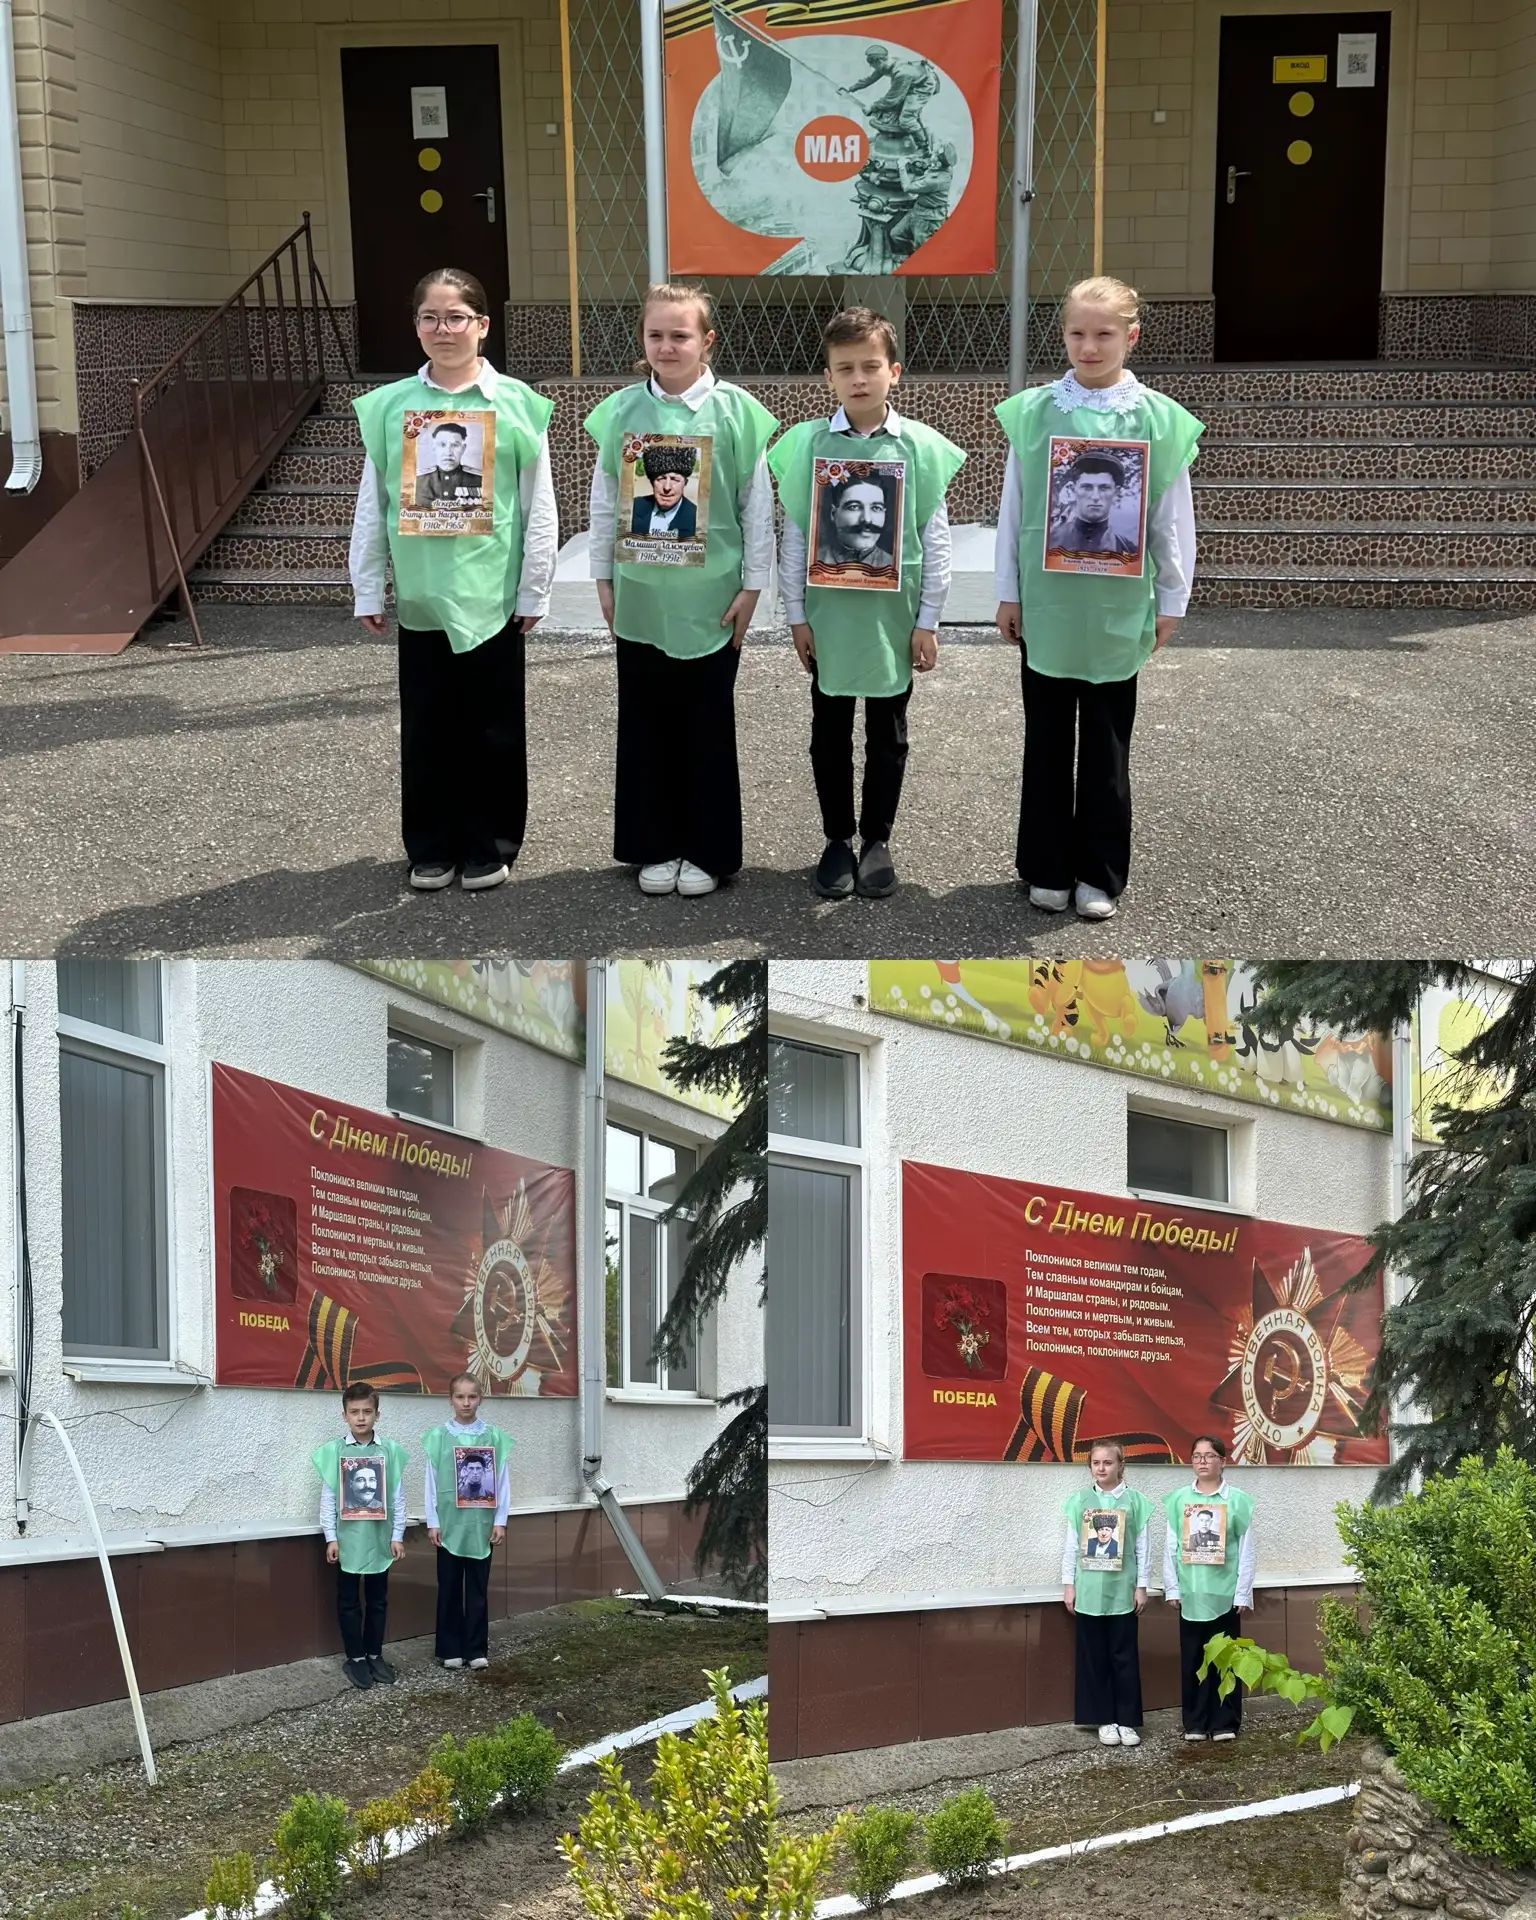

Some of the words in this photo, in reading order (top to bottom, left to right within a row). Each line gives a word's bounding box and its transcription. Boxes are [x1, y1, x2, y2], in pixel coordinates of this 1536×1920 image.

[804, 135, 861, 163] МАЯ
[309, 1109, 328, 1140] С
[328, 1115, 389, 1157] Днем
[392, 1132, 473, 1179] Победы!
[311, 1166, 355, 1187] Поклонимся
[356, 1180, 385, 1194] великим
[386, 1187, 398, 1198] тем
[311, 1185, 325, 1199] Тем
[327, 1192, 359, 1207] славным
[361, 1199, 401, 1216] командирам
[402, 1208, 406, 1216] и
[311, 1204, 317, 1217] И
[319, 1205, 356, 1225] Маршалам
[386, 1222, 390, 1231] и
[1024, 1196, 1047, 1226] С
[1048, 1200, 1125, 1238] Днем
[1130, 1212, 1239, 1254] Победы!
[311, 1223, 355, 1242] Поклонимся
[357, 1235, 361, 1243] и
[396, 1241, 400, 1250] и
[312, 1242, 330, 1256] Всем
[348, 1251, 377, 1266] которых
[378, 1255, 409, 1269] забывать
[1025, 1250, 1082, 1268] Поклонимся
[1084, 1259, 1121, 1272] великим
[1123, 1264, 1138, 1275] тем
[1140, 1266, 1167, 1280] годам,
[359, 1272, 398, 1285] поклонимся
[1025, 1267, 1044, 1280] Тем
[1046, 1271, 1087, 1286] славным
[1090, 1277, 1142, 1294] командирам
[1143, 1284, 1149, 1293] и
[1151, 1283, 1184, 1298] бойцам,
[1026, 1285, 1033, 1297] И
[1036, 1285, 1083, 1303] Маршалам
[1086, 1294, 1120, 1308] страны,
[1122, 1297, 1128, 1306] и
[1130, 1299, 1171, 1312] рядовым.
[240, 1311, 290, 1332] ПОБЕДА
[1026, 1303, 1082, 1320] Поклонимся
[1085, 1312, 1090, 1320] и
[1092, 1313, 1135, 1326] мертвым,
[1136, 1317, 1142, 1326] и
[1143, 1317, 1175, 1329] живым.
[1026, 1321, 1050, 1335] Всем
[1053, 1325, 1071, 1338] тем,
[1073, 1327, 1111, 1341] которых
[1113, 1330, 1153, 1343] забывать
[1155, 1336, 1186, 1348] нельзя,
[1026, 1339, 1085, 1357] Поклонимся,
[1087, 1346, 1139, 1359] поклонимся
[1141, 1350, 1172, 1363] друзья.
[933, 1389, 997, 1408] ПОБЕДА
